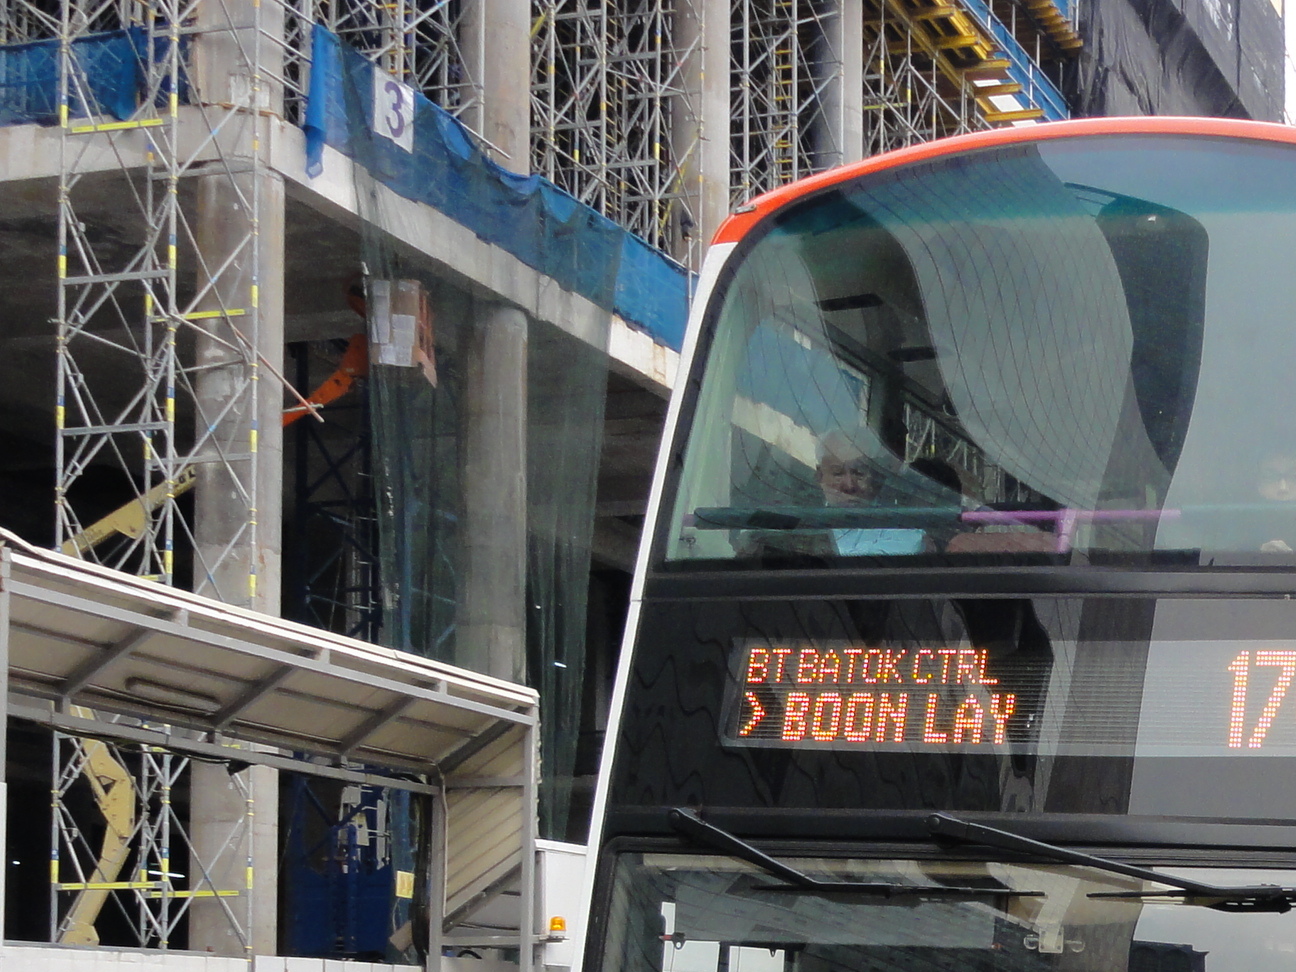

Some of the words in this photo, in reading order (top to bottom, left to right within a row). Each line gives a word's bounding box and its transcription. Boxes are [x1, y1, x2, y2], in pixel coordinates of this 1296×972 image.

[384, 80, 405, 138] 3
[748, 648, 792, 684] BT
[797, 648, 907, 685] BATOK
[912, 648, 998, 685] CTRL
[781, 692, 909, 743] BOON
[923, 693, 1016, 744] LAY
